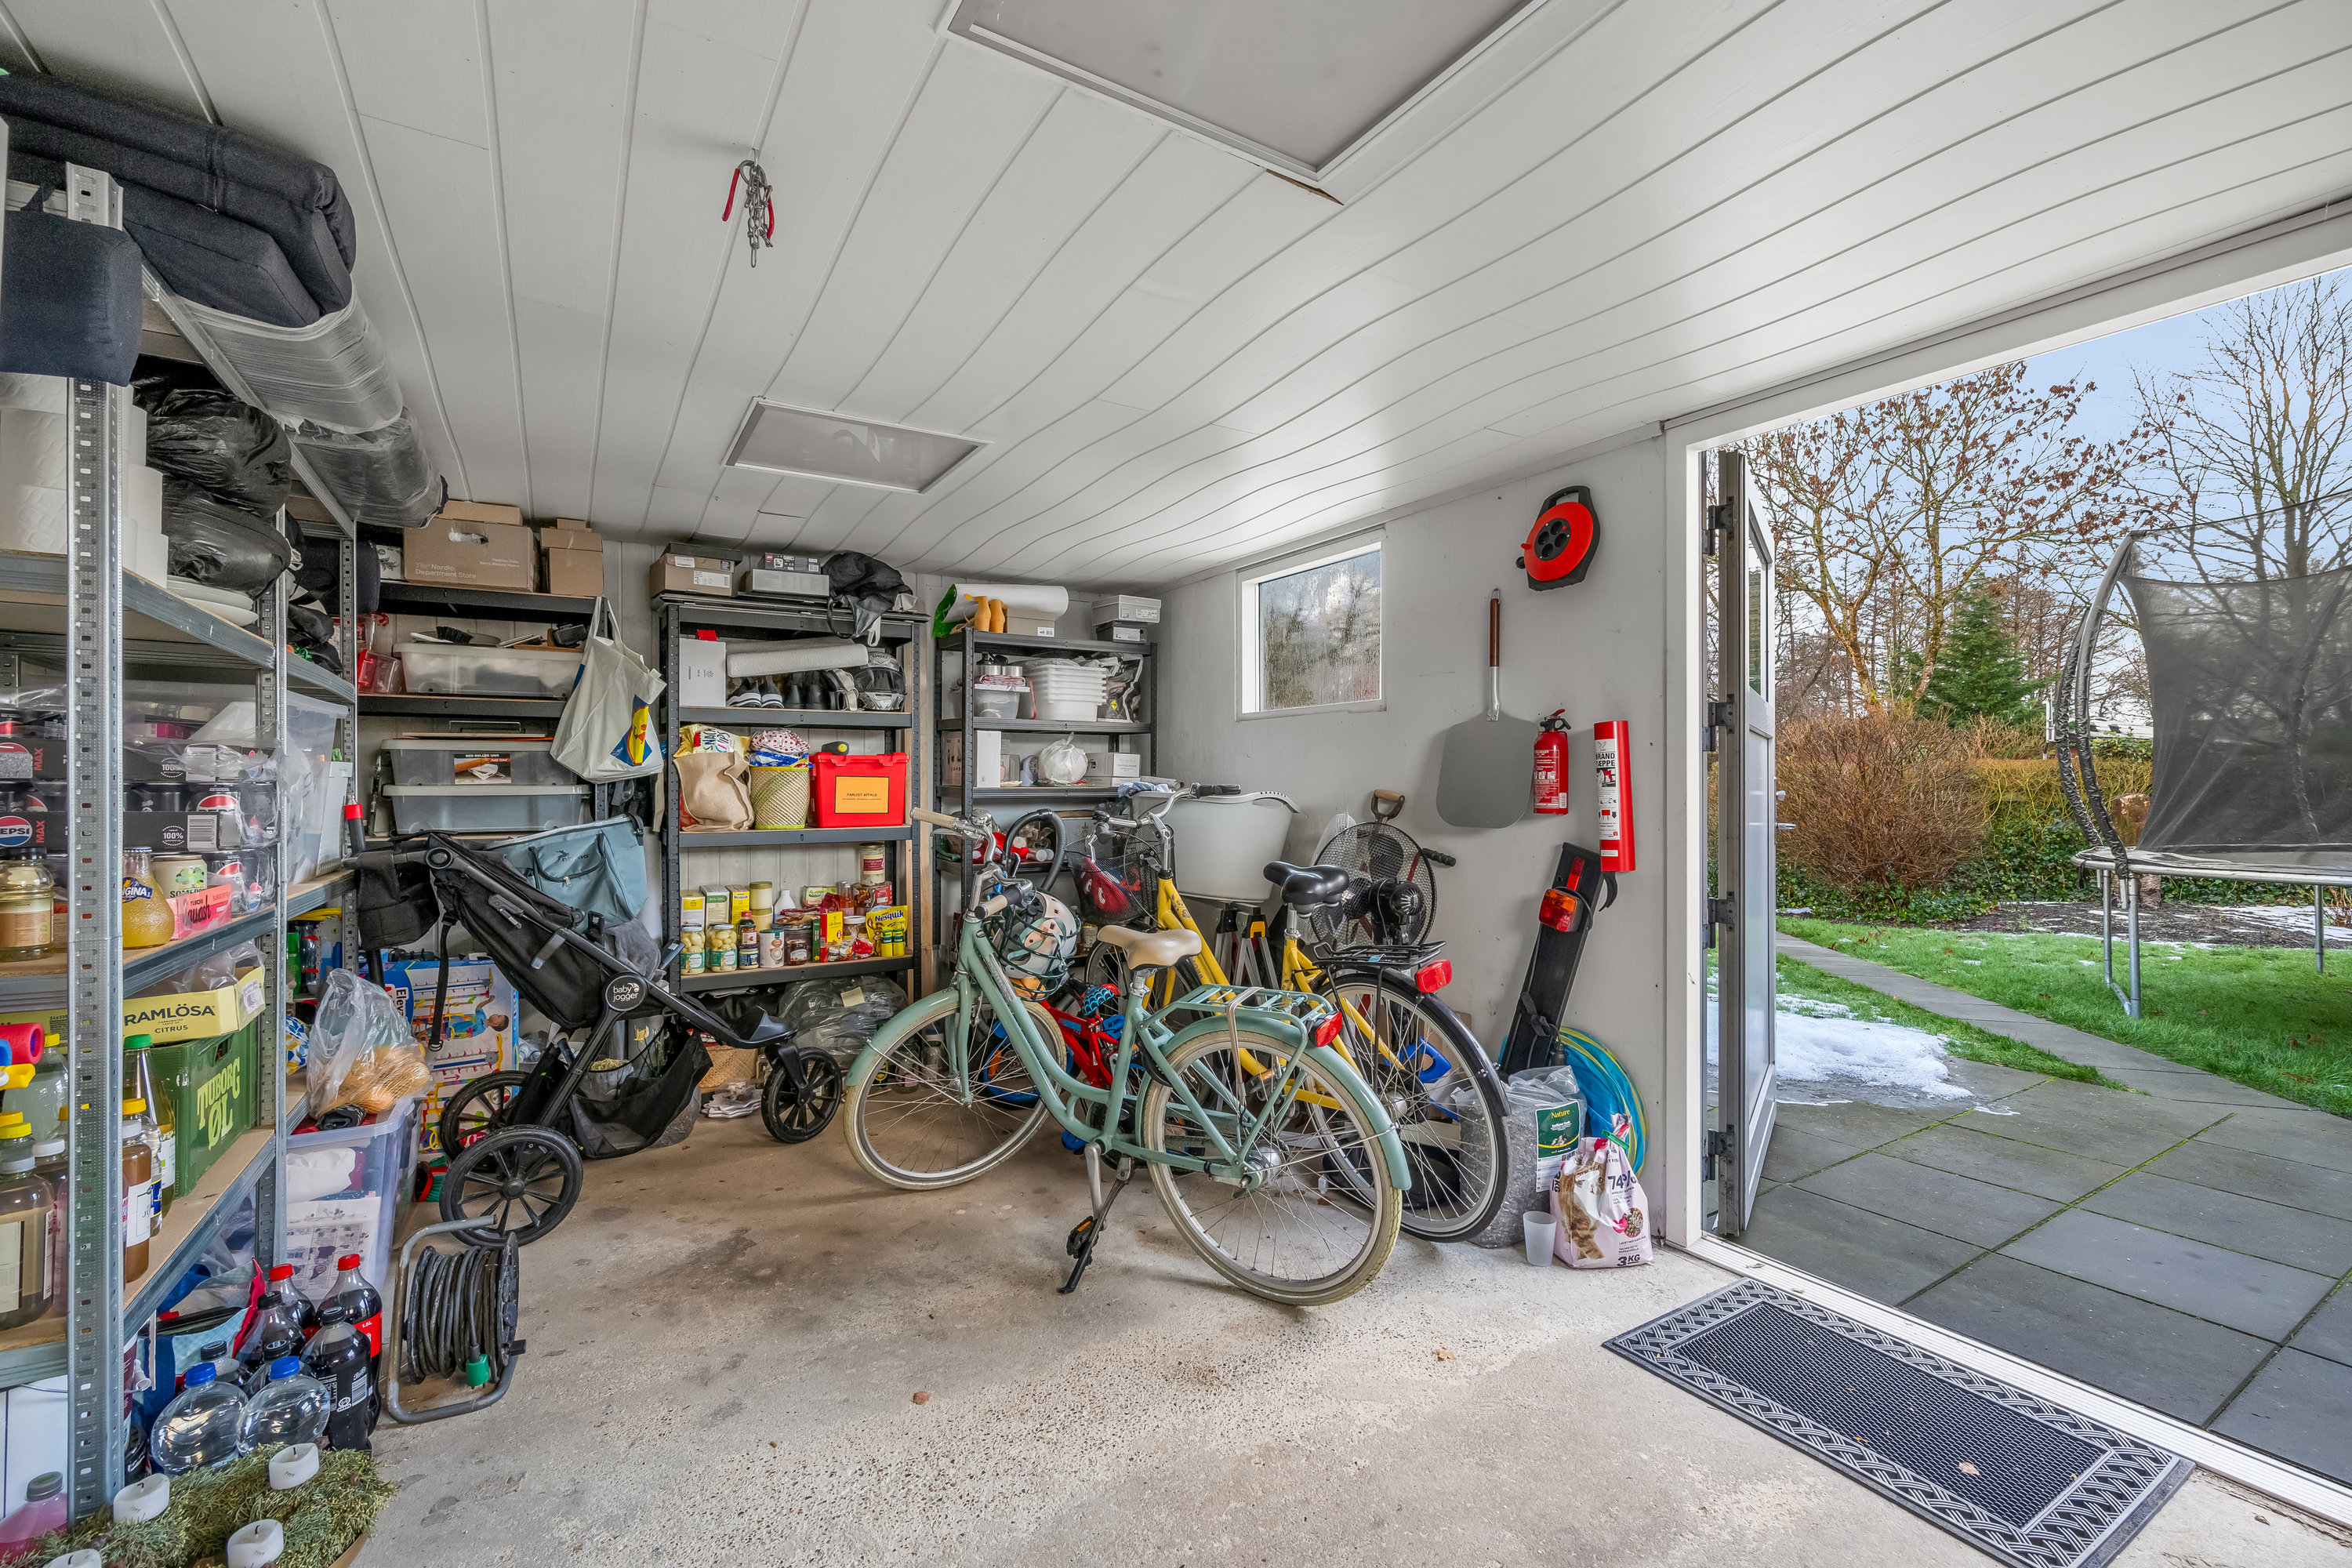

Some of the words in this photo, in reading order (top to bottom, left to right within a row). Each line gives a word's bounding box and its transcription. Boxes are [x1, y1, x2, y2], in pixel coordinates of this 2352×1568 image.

[416, 569, 456, 578] Department
[34, 747, 43, 771] MAX
[36, 820, 45, 843] MAX
[875, 909, 904, 921] Nesquik
[613, 985, 632, 994] baby
[612, 993, 639, 1003] jogger
[124, 1004, 216, 1026] RAMLÖSA
[154, 1025, 189, 1033] CITRUS
[197, 1056, 241, 1131] TUBORG
[208, 1092, 234, 1151] ØL
[1551, 1109, 1570, 1119] Nature
[1607, 1170, 1637, 1190] 74%
